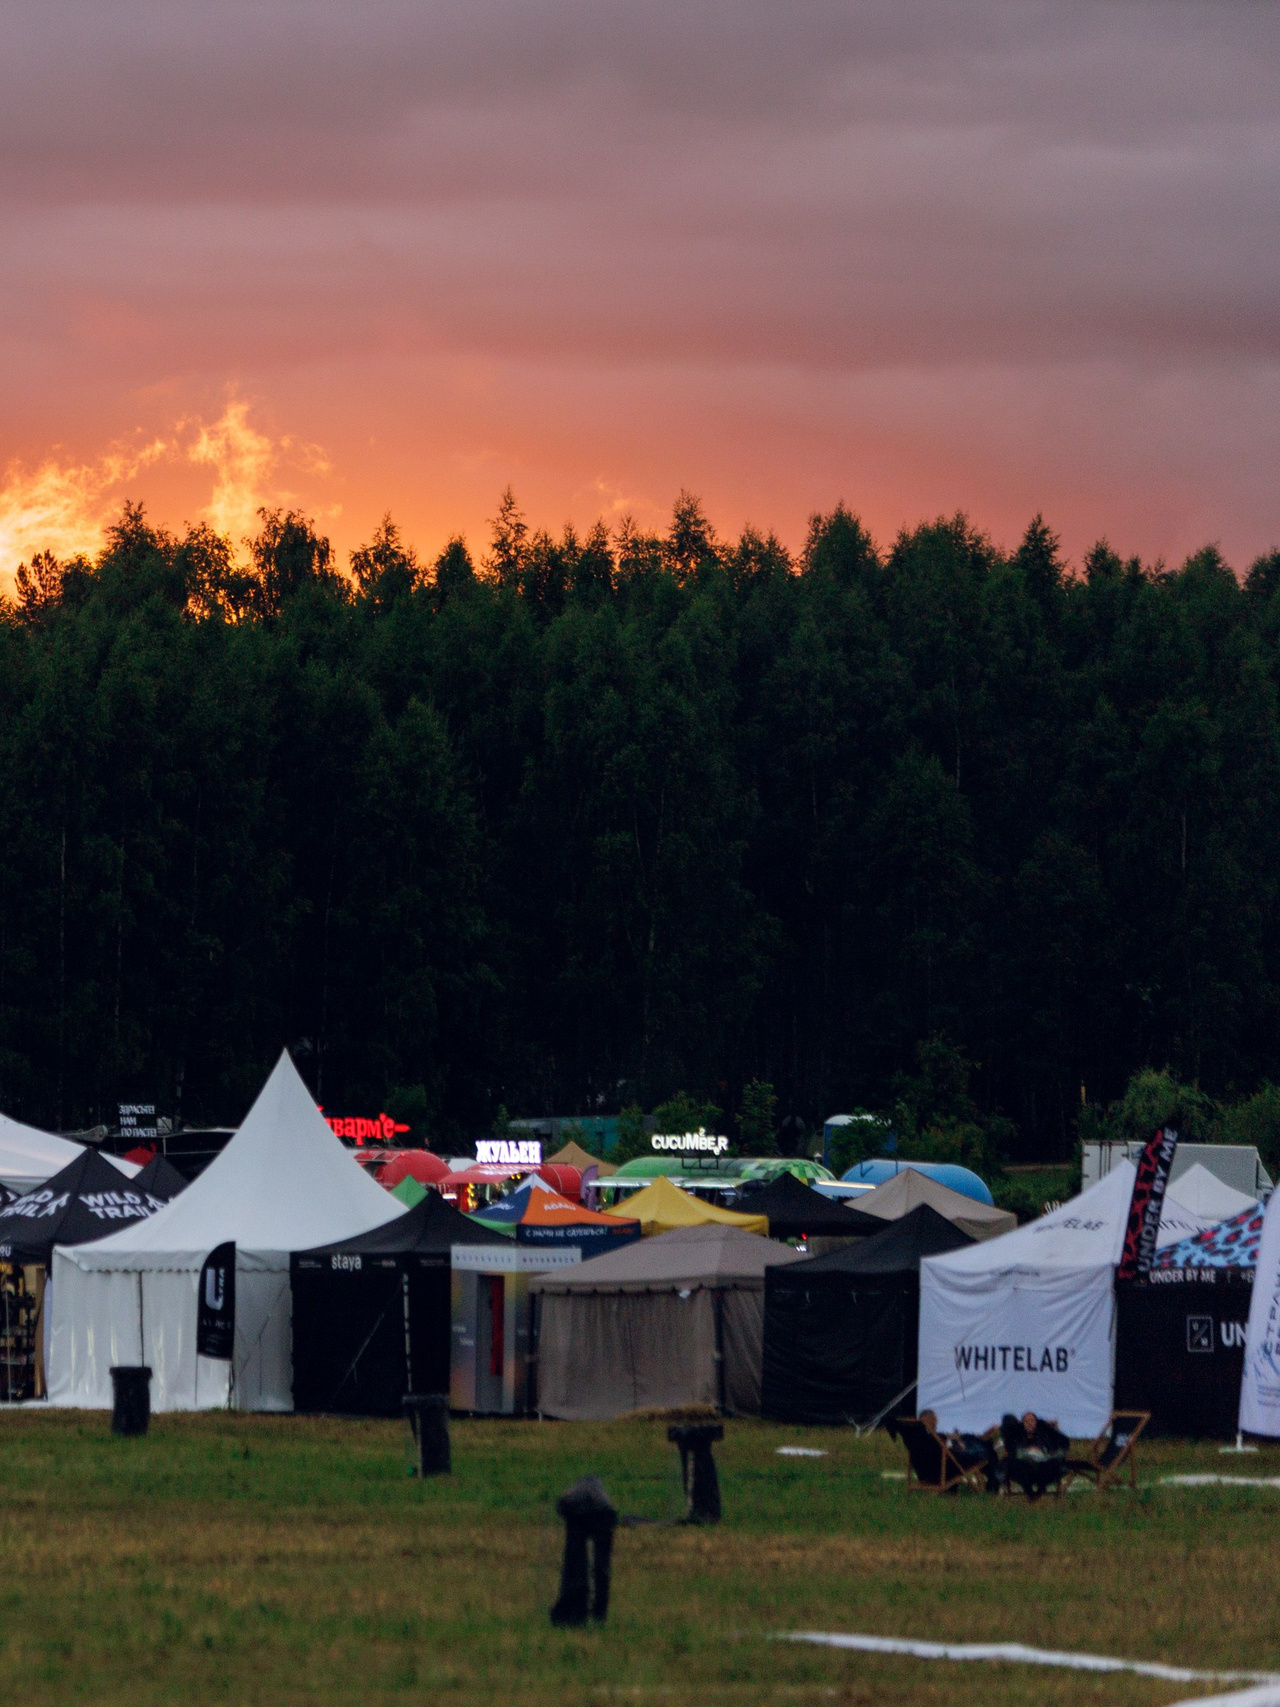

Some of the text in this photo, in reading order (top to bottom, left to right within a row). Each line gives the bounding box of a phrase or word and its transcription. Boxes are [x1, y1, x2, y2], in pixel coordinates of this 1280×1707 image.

[475, 1140, 542, 1164] ЖУЛЬЕН
[79, 1191, 141, 1205] WILD
[331, 1254, 362, 1272] staya
[1149, 1269, 1185, 1284] UNDER
[1186, 1269, 1199, 1282] BY
[955, 1345, 1069, 1373] WHITELAB
